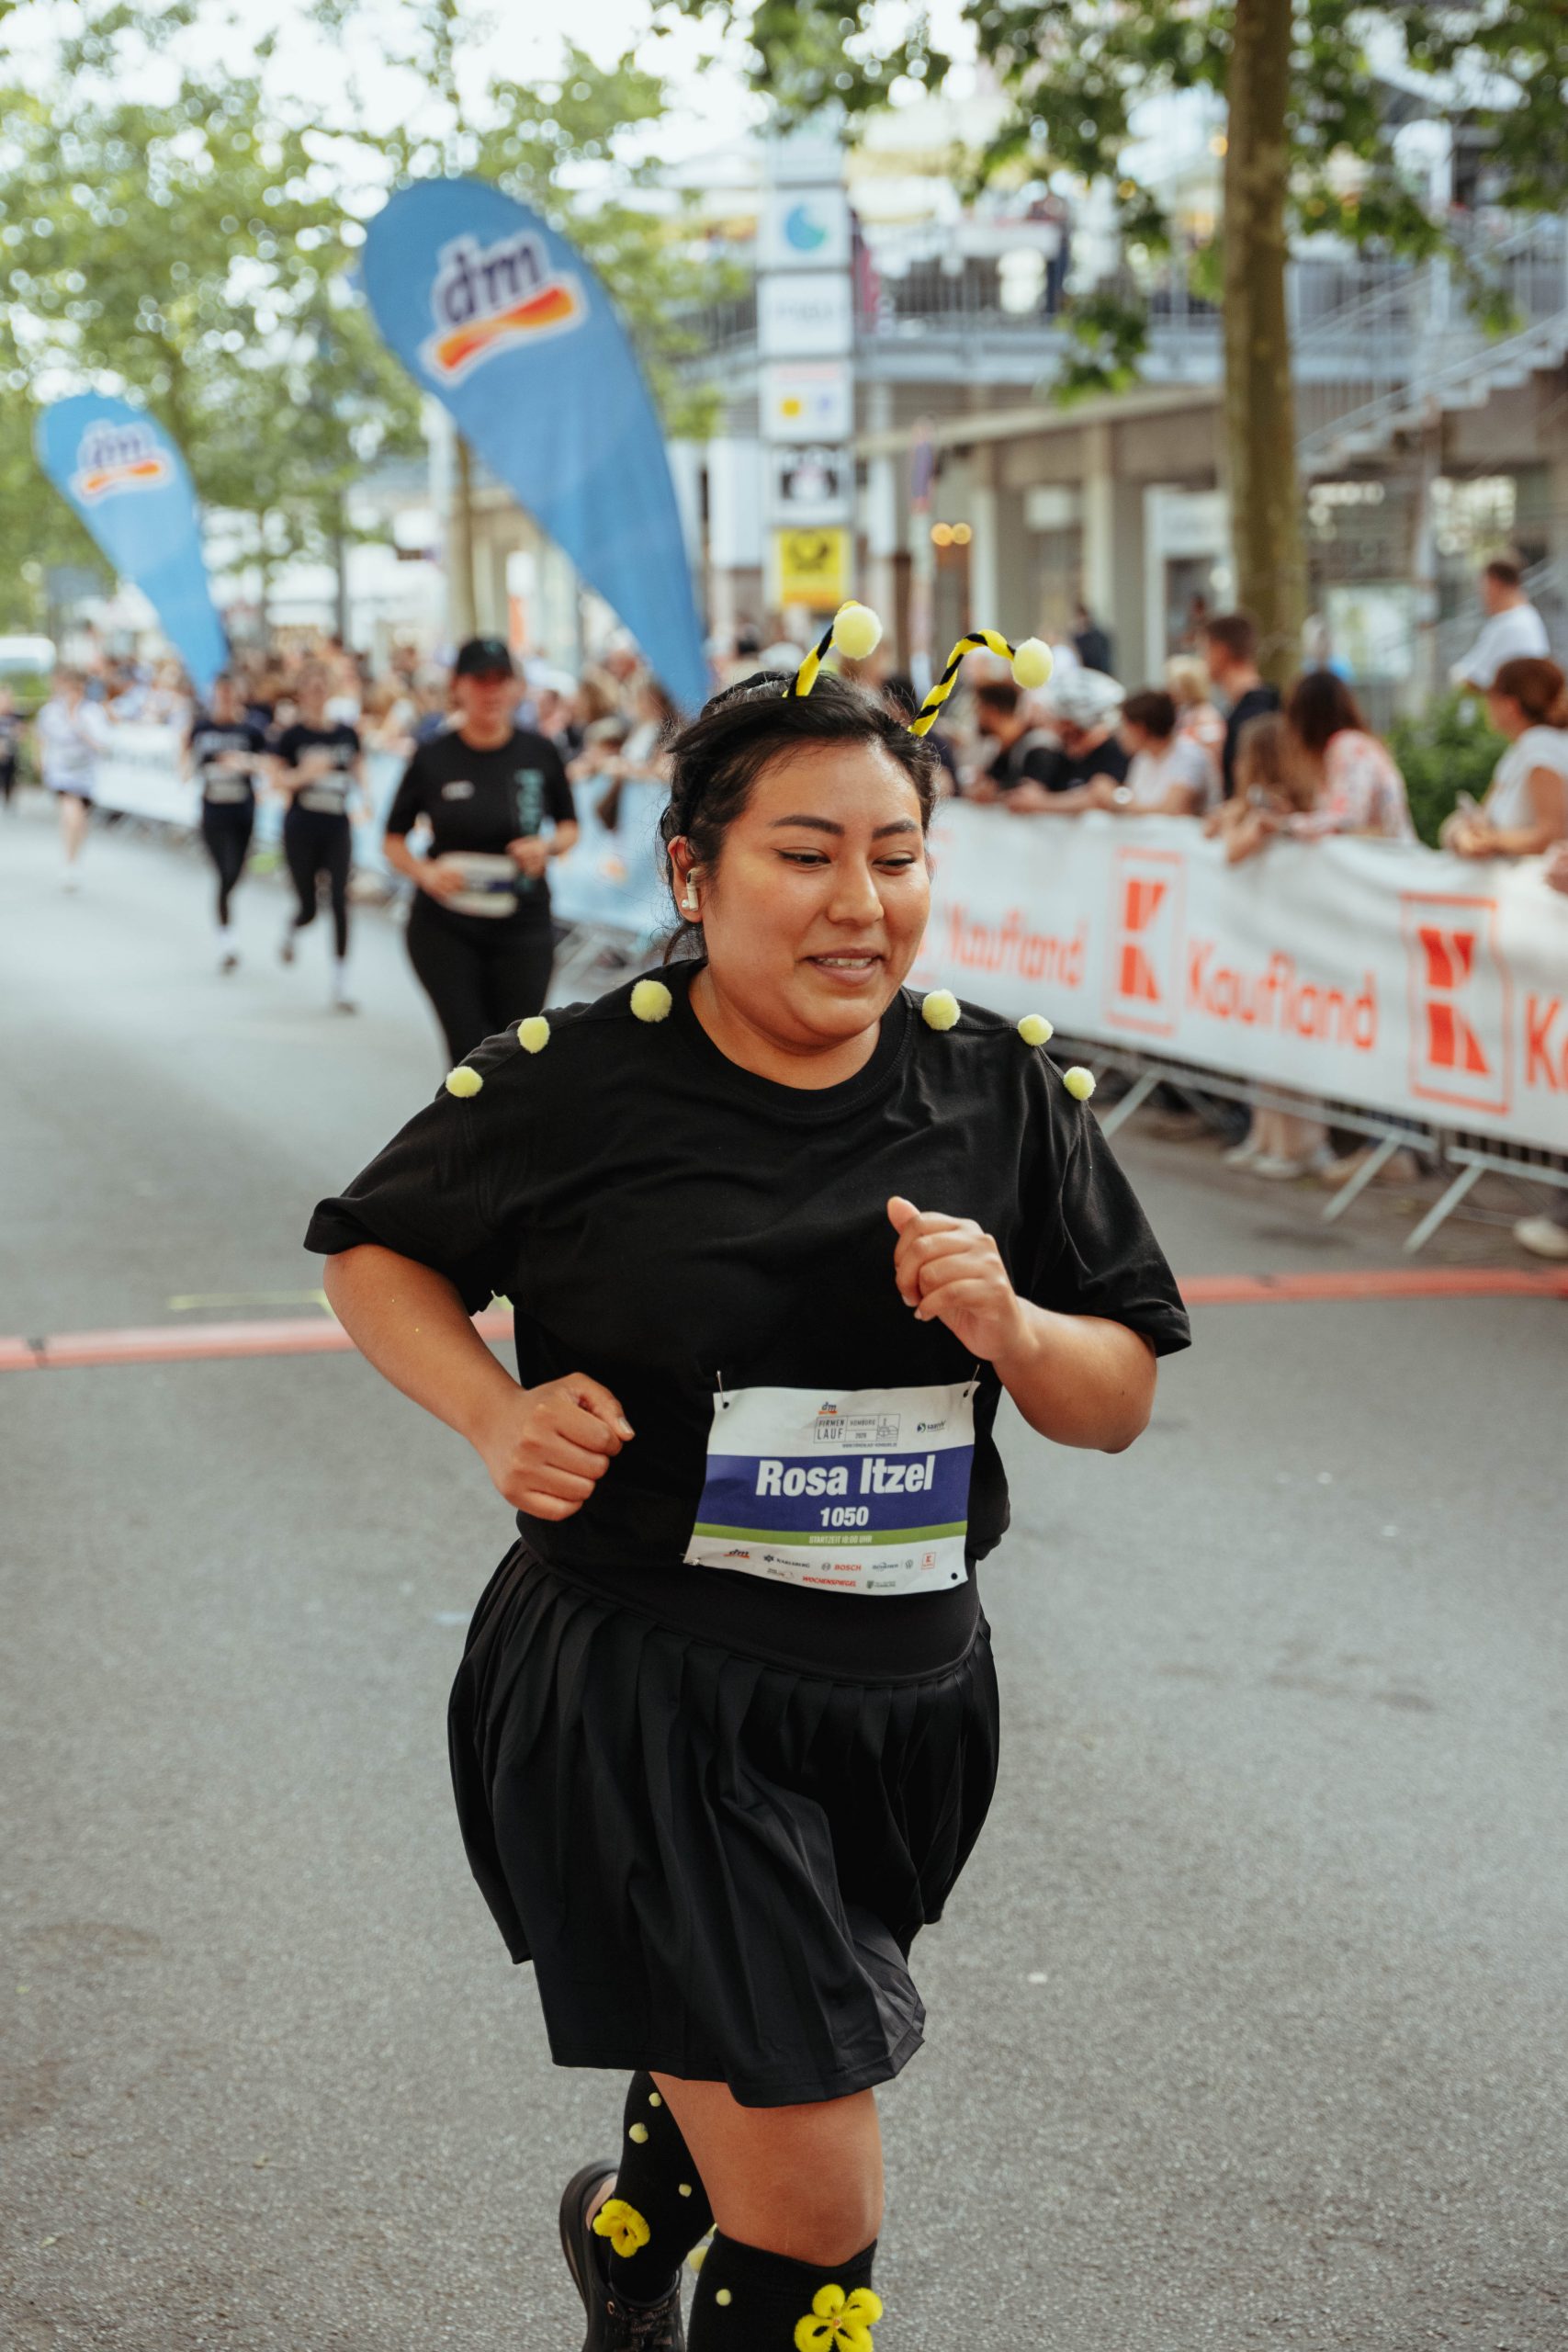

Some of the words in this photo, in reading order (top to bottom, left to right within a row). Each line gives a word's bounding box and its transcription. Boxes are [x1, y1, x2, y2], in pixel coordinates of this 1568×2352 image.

[443, 246, 540, 323] dm
[1189, 941, 1378, 1052] Kaufland
[1525, 992, 1568, 1093] K
[821, 1401, 837, 1411] dm
[818, 1419, 845, 1427] FIRMEN
[817, 1428, 843, 1440] LAUF
[755, 1459, 849, 1497] Rosa
[860, 1454, 936, 1494] Itzel
[820, 1506, 869, 1527] 1050
[808, 1535, 840, 1544] STARTZEIT
